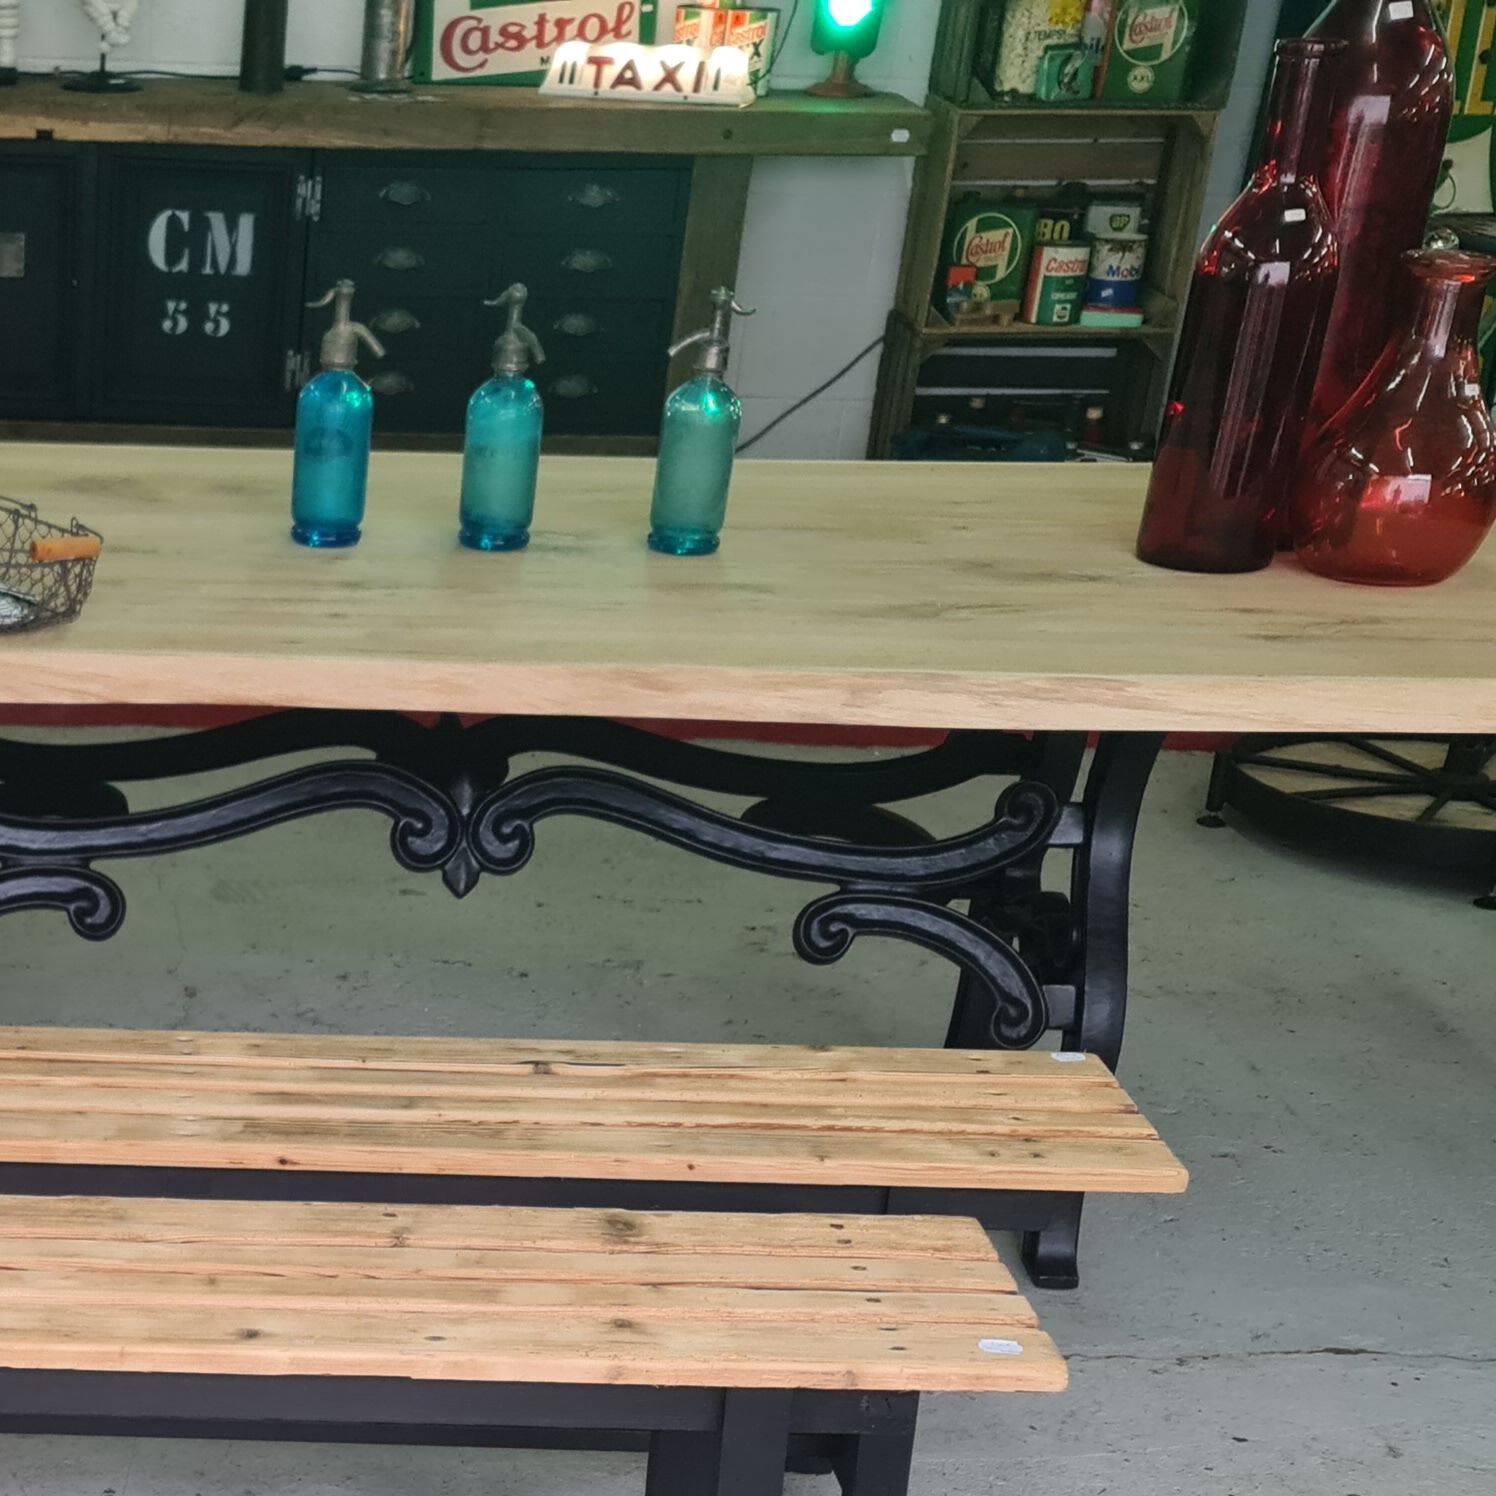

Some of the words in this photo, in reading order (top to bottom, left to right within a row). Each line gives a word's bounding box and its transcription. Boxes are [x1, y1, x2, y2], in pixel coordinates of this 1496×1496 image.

[439, 0, 636, 74] Castrol
[587, 56, 706, 94] TAXI
[148, 208, 255, 276] CM
[162, 300, 230, 337] 55
